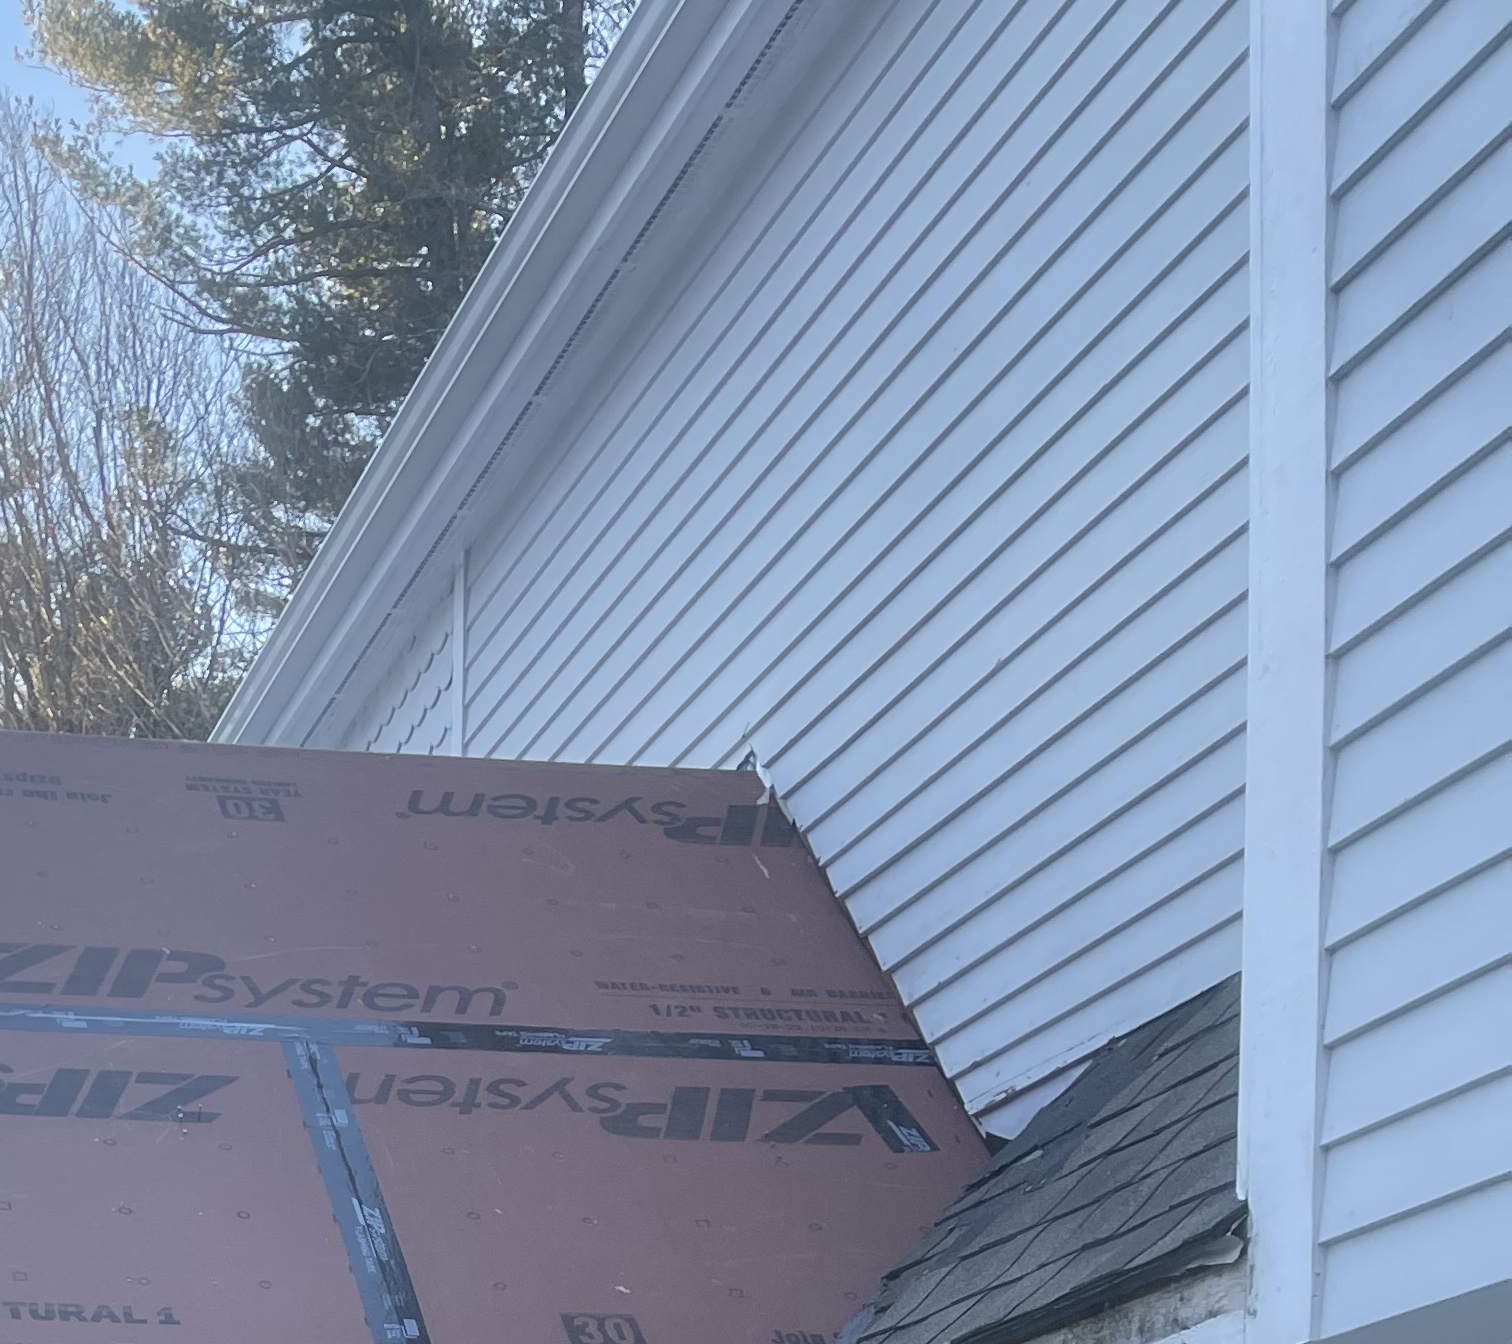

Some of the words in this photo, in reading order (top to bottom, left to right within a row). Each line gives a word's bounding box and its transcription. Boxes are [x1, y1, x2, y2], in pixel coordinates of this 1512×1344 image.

[223, 797, 278, 821] 30
[715, 1005, 874, 1024] STRUCTURAL
[156, 1306, 182, 1326] 1
